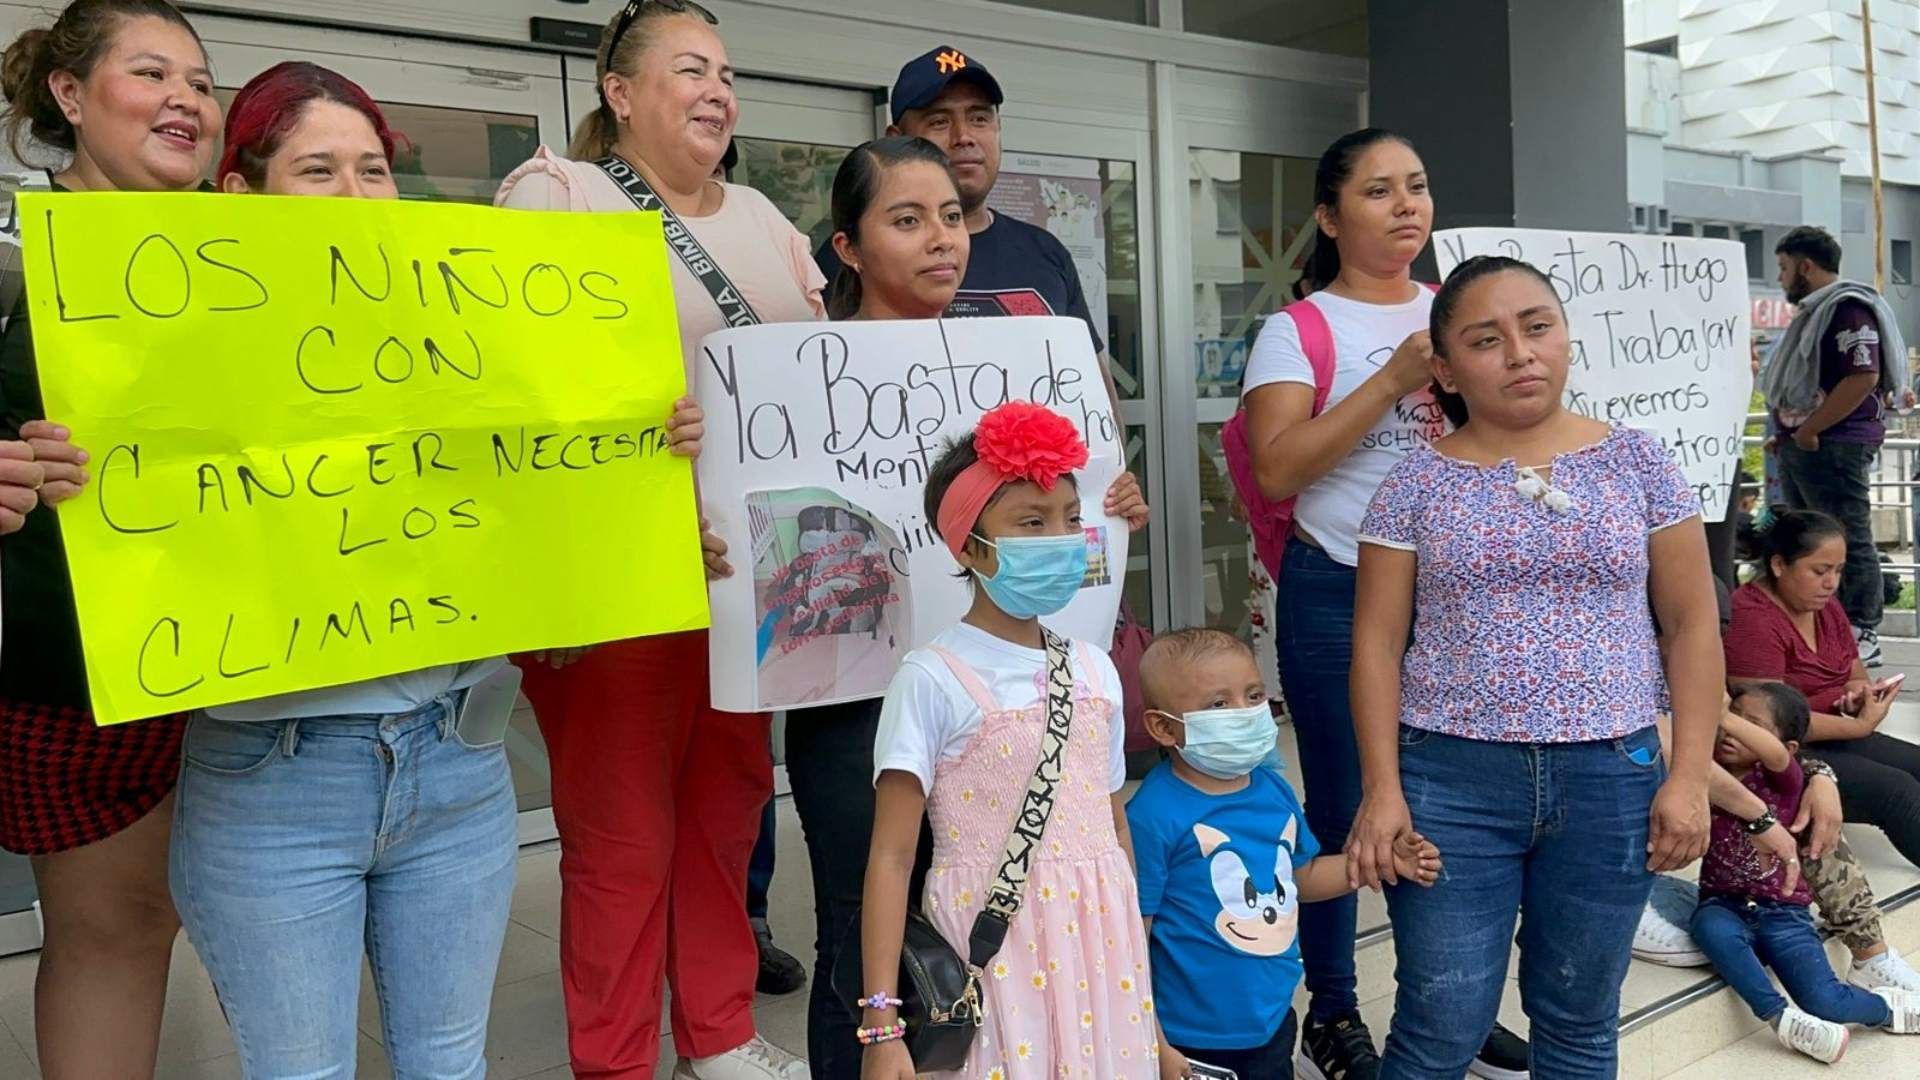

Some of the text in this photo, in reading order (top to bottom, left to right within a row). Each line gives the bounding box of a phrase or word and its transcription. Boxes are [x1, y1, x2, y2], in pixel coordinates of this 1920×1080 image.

[46, 209, 628, 322] LOS NIÑOS
[1608, 240, 1653, 291] Dr.
[1660, 242, 1727, 302] Hugo
[296, 325, 482, 394] CON
[1593, 309, 1737, 372] Trabajar
[703, 318, 1083, 464] Ya Basta de
[1362, 427, 1445, 449] SCHNA
[98, 432, 459, 533] CANCER
[339, 499, 480, 556] LOS
[138, 594, 478, 697] CLIMAS.
